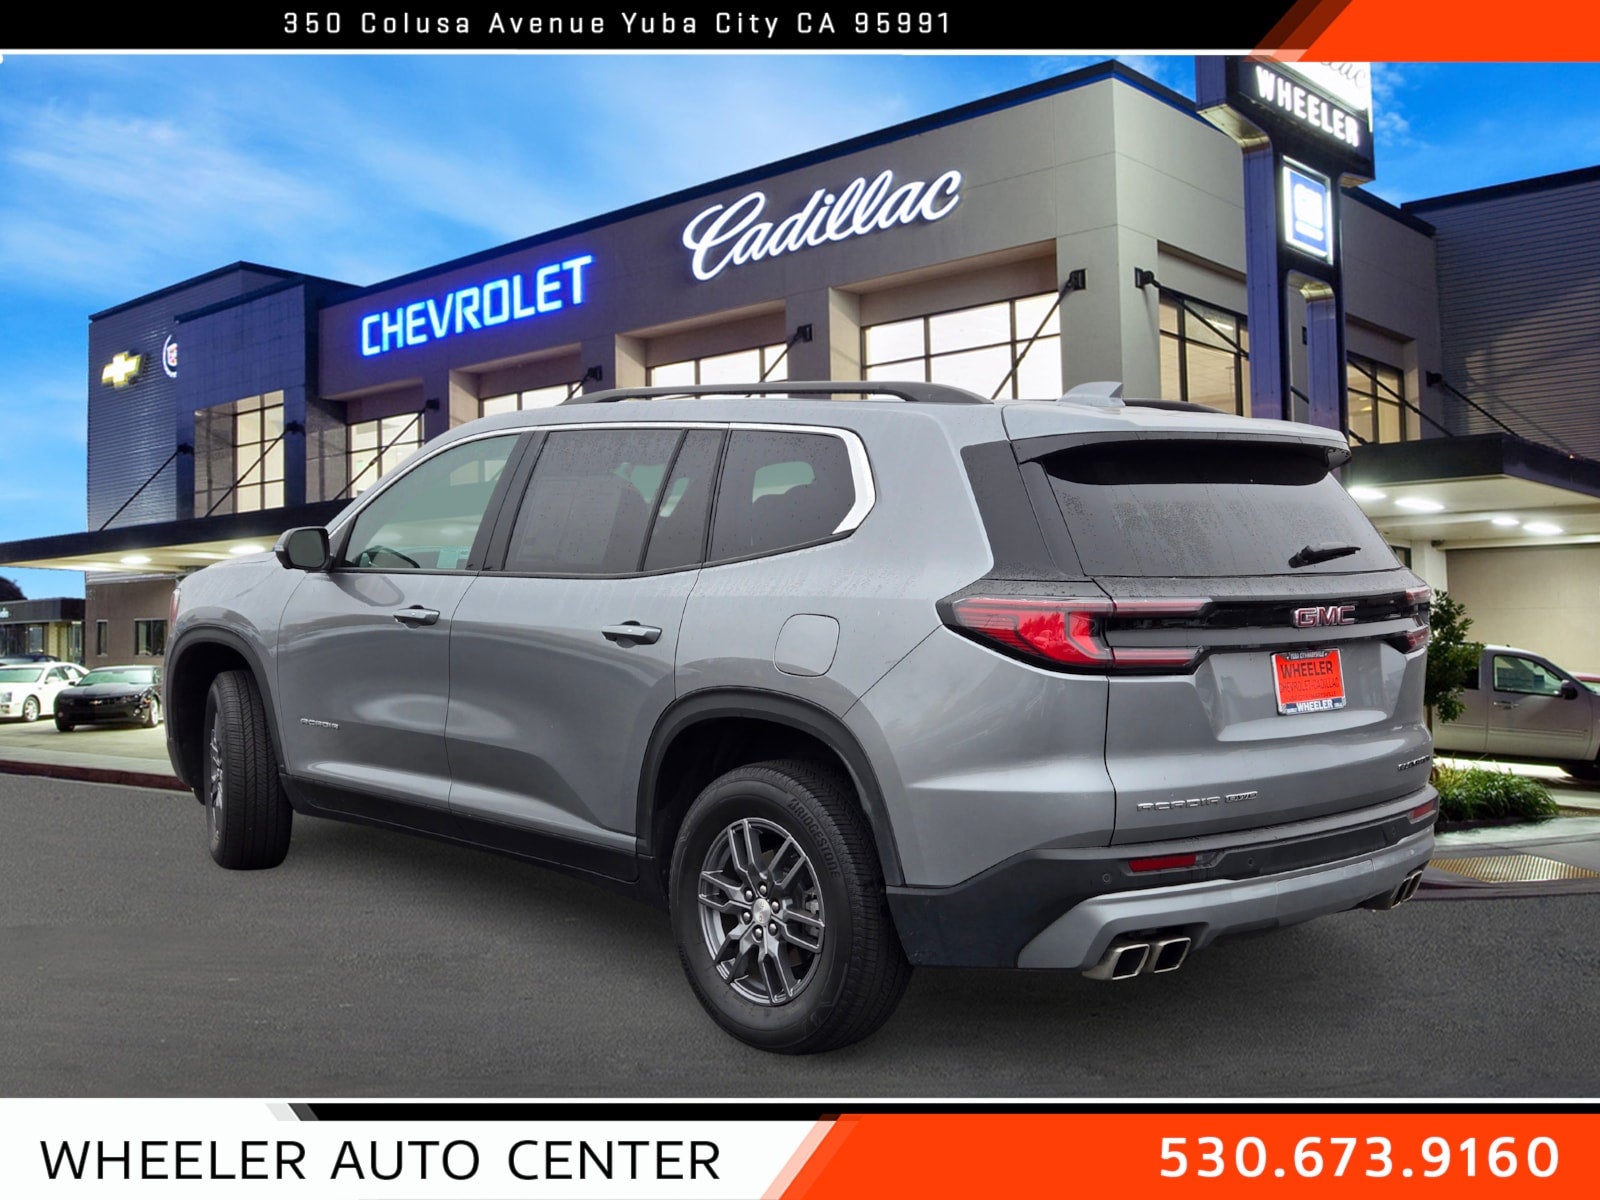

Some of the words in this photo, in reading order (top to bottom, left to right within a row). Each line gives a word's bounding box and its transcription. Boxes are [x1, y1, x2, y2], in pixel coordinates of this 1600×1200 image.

[1255, 65, 1359, 147] WHEELER
[682, 169, 962, 281] Cadillac
[361, 254, 593, 357] CHEVROLET
[1294, 605, 1356, 628] GMC
[1280, 660, 1334, 679] WHEELER
[1296, 700, 1334, 712] WHEELER
[787, 798, 841, 878] BRIDGESTONE
